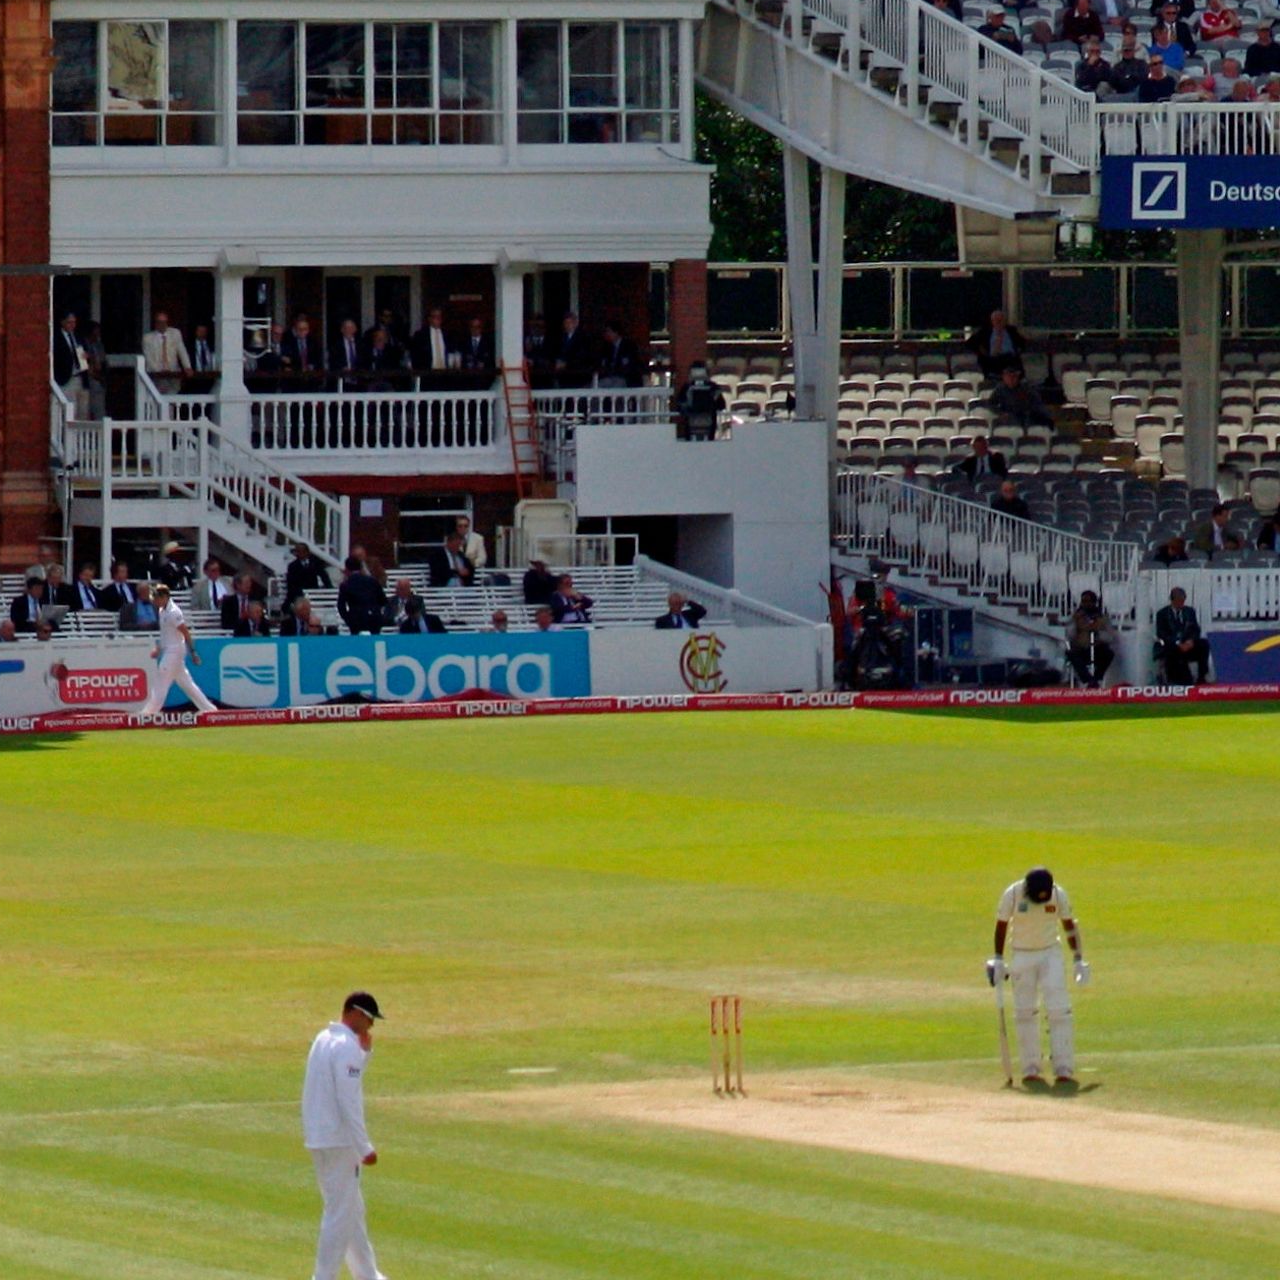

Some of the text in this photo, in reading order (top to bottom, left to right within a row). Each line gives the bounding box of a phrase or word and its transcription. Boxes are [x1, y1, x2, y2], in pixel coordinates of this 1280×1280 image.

[66, 674, 139, 688] npower
[288, 640, 551, 704] Lebara
[67, 689, 140, 698] TEST SERIES
[128, 710, 202, 726] npower
[290, 704, 368, 719] npower
[456, 700, 533, 715] npower
[617, 694, 693, 708] npower
[783, 692, 861, 706] npower
[950, 689, 1028, 704] npower
[1117, 684, 1195, 699] npower
